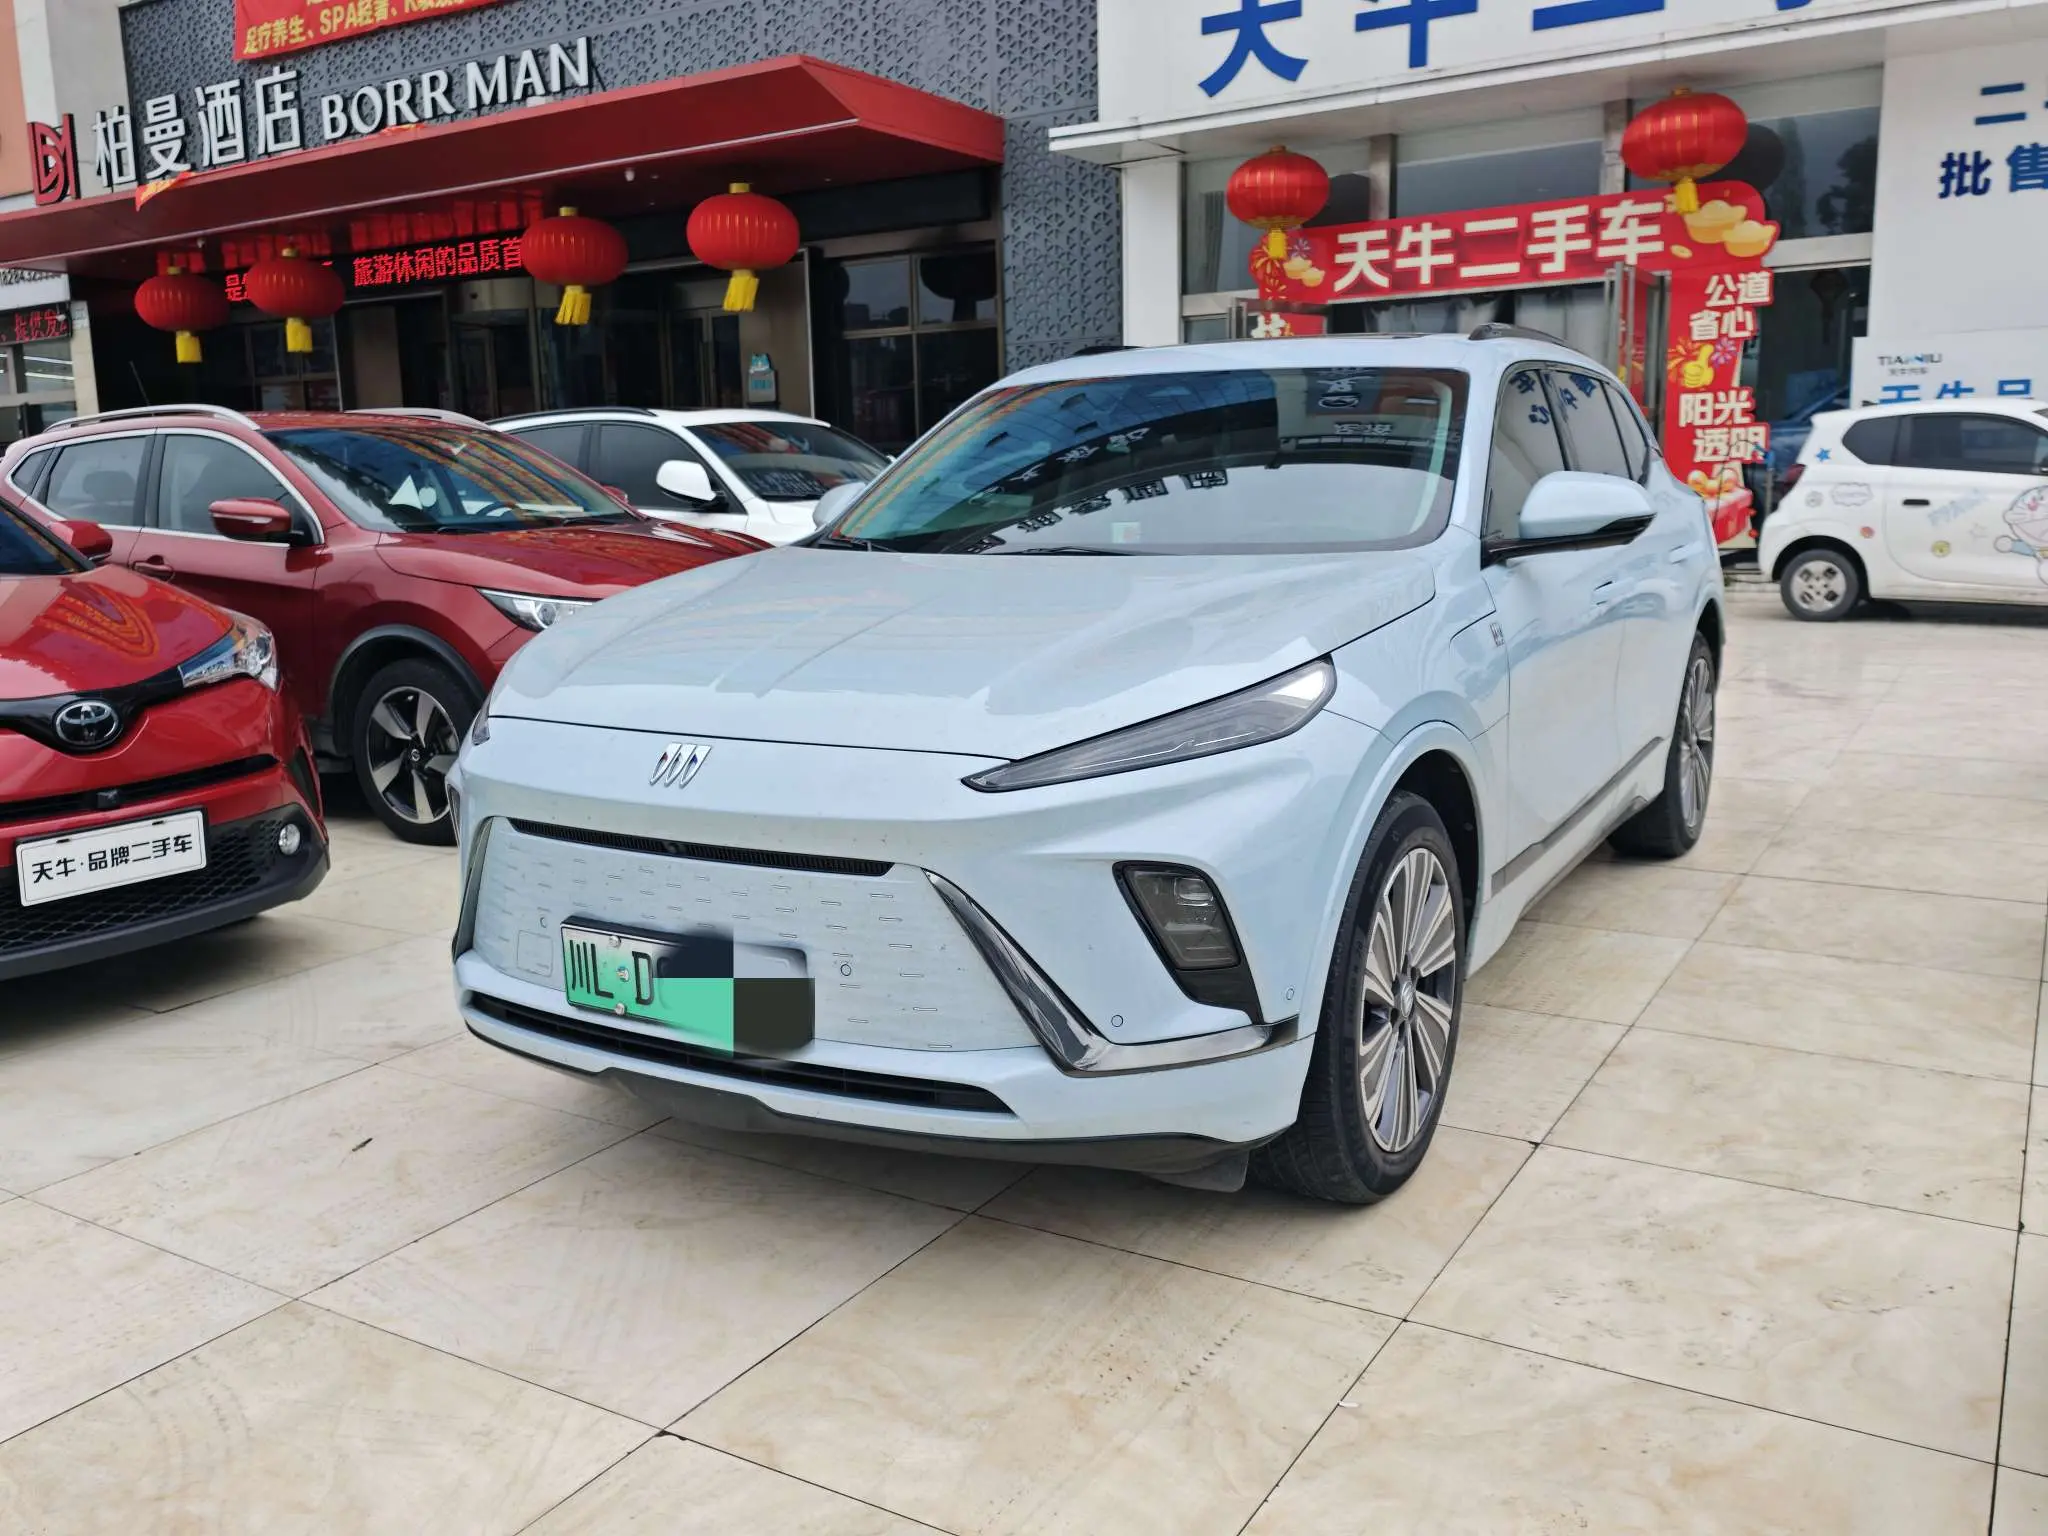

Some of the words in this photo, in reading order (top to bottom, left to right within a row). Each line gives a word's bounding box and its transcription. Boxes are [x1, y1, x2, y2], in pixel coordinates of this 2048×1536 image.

[1973, 82, 2048, 126] 二
[93, 67, 302, 188] 柏曼酒店
[1333, 200, 1665, 293] 天牛二手车
[1704, 271, 1770, 308] 公道
[1689, 306, 1754, 341] 省心
[1679, 389, 1751, 427] 阳光
[1693, 425, 1766, 463] 透明
[31, 833, 193, 884] 天牛·品牌二手车
